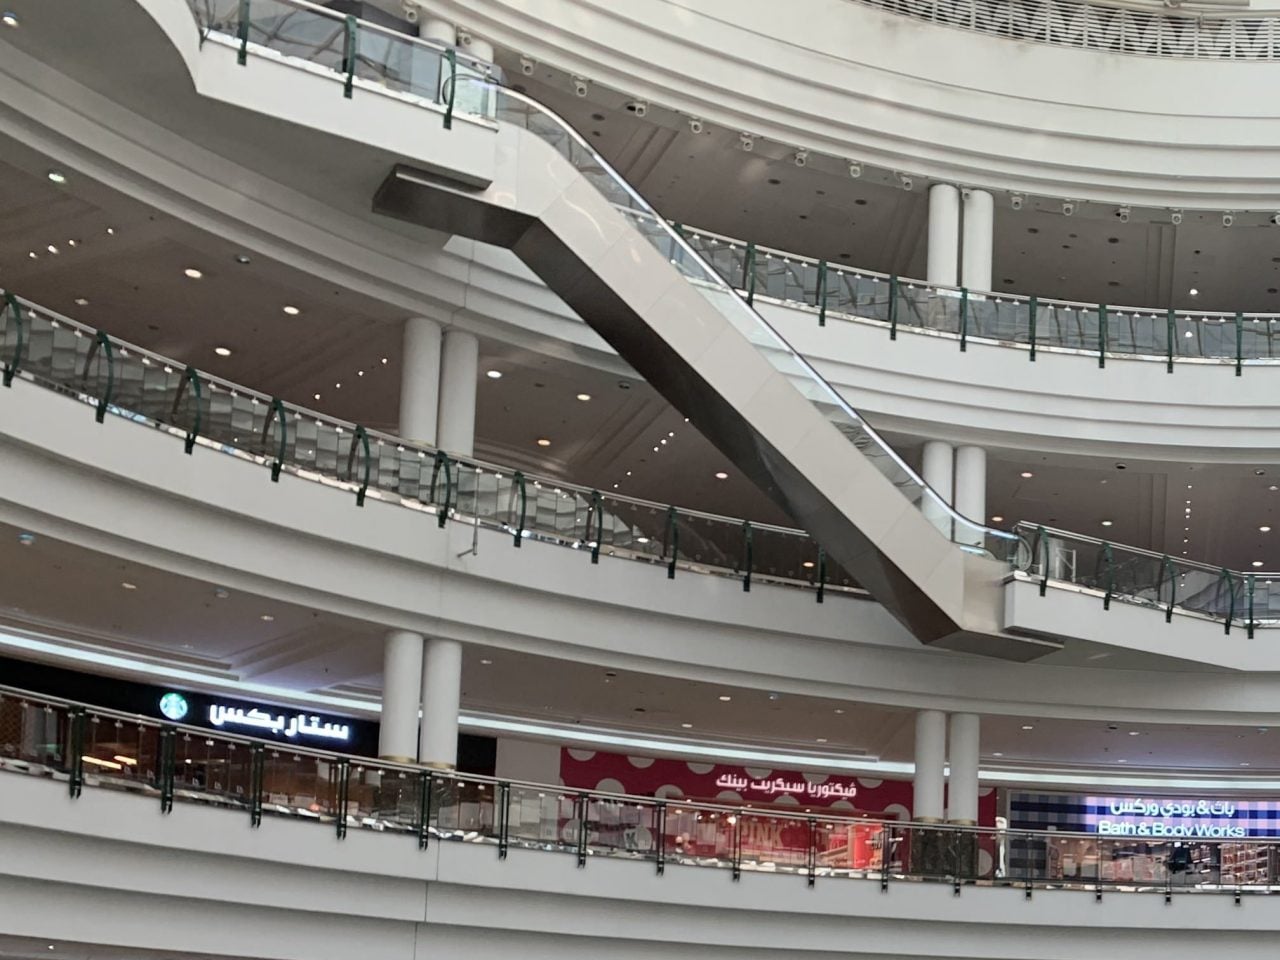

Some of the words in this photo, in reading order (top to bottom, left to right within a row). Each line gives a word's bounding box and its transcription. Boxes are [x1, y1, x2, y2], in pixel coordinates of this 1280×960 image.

[208, 703, 350, 740] ستاربكس
[716, 773, 748, 792] بينك
[1098, 821, 1137, 835] Bath
[1194, 824, 1245, 838] Works
